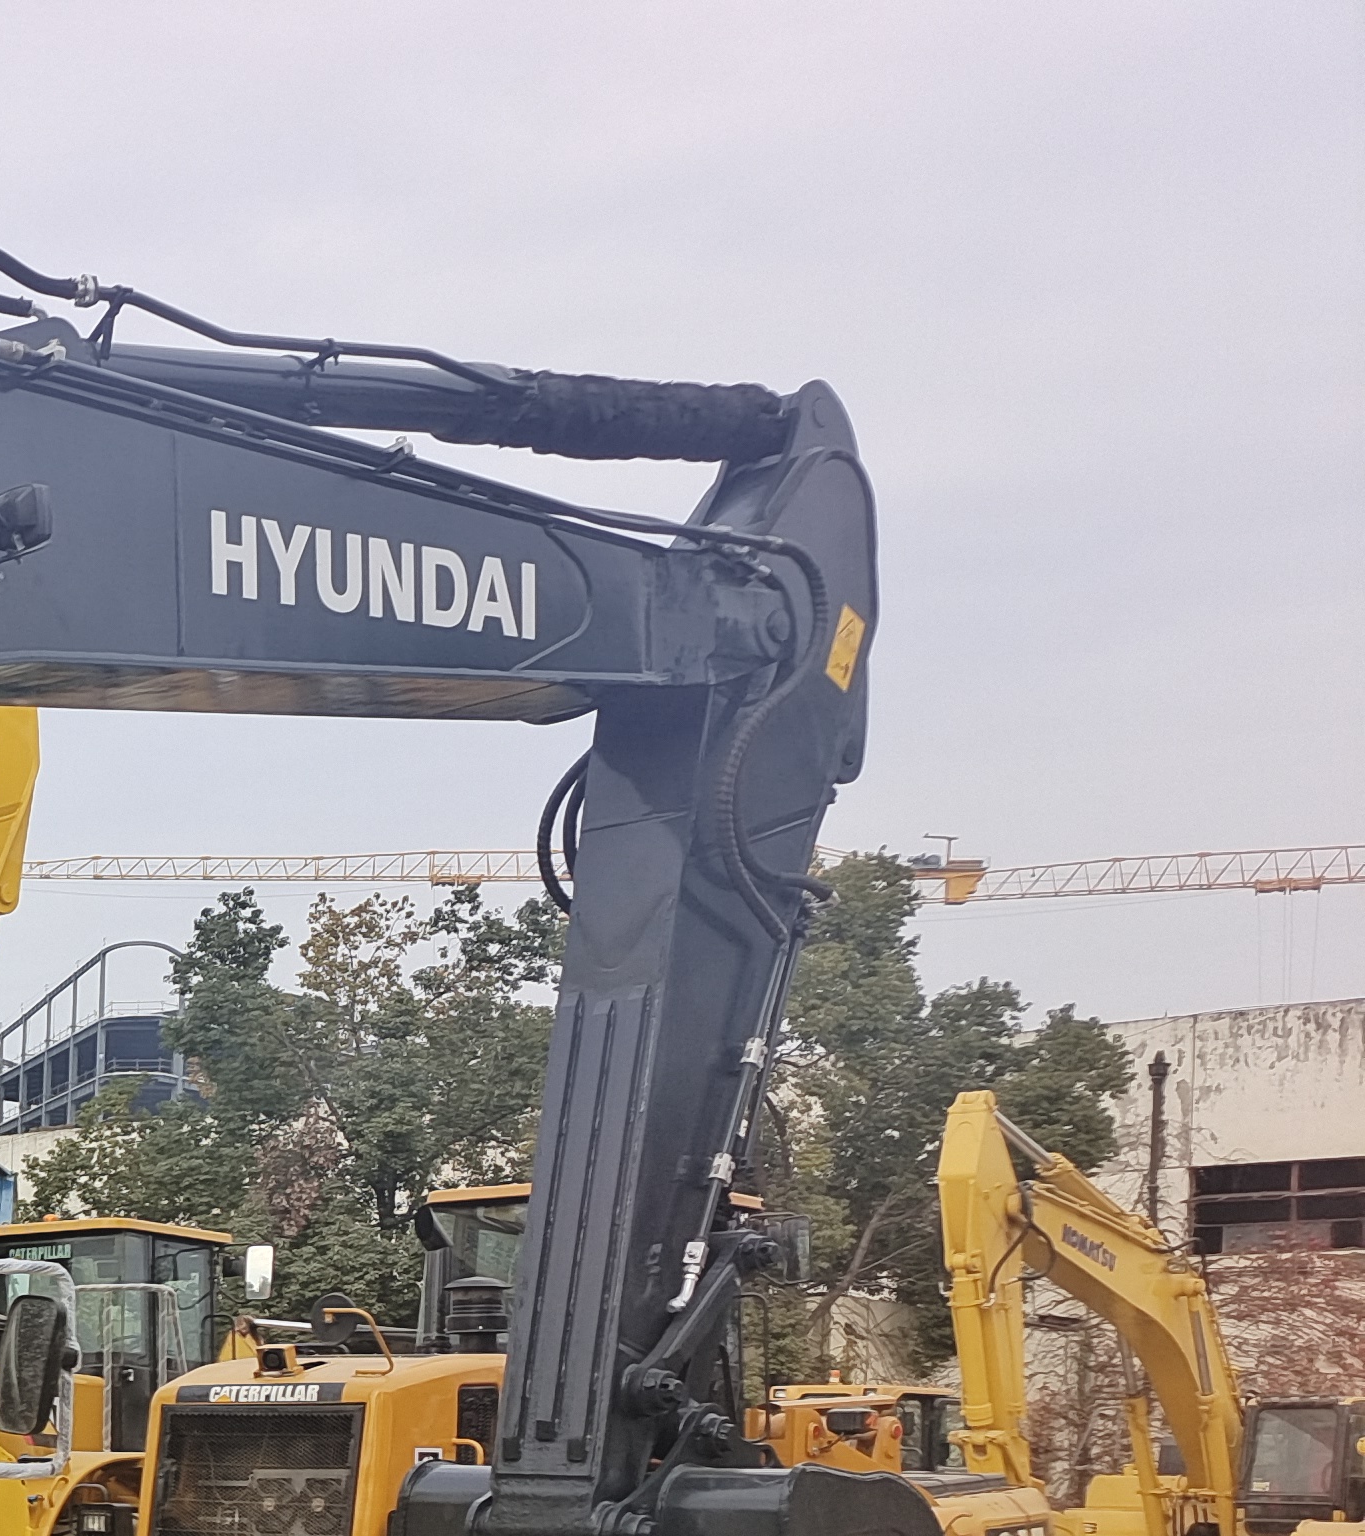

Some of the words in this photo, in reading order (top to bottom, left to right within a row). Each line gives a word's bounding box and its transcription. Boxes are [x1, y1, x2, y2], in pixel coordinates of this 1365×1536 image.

[210, 509, 536, 640] HYUNDAI
[9, 1243, 72, 1260] CATERPILLAR
[1062, 1223, 1117, 1272] KOMATSU
[208, 1384, 320, 1403] CATERPILLAR
